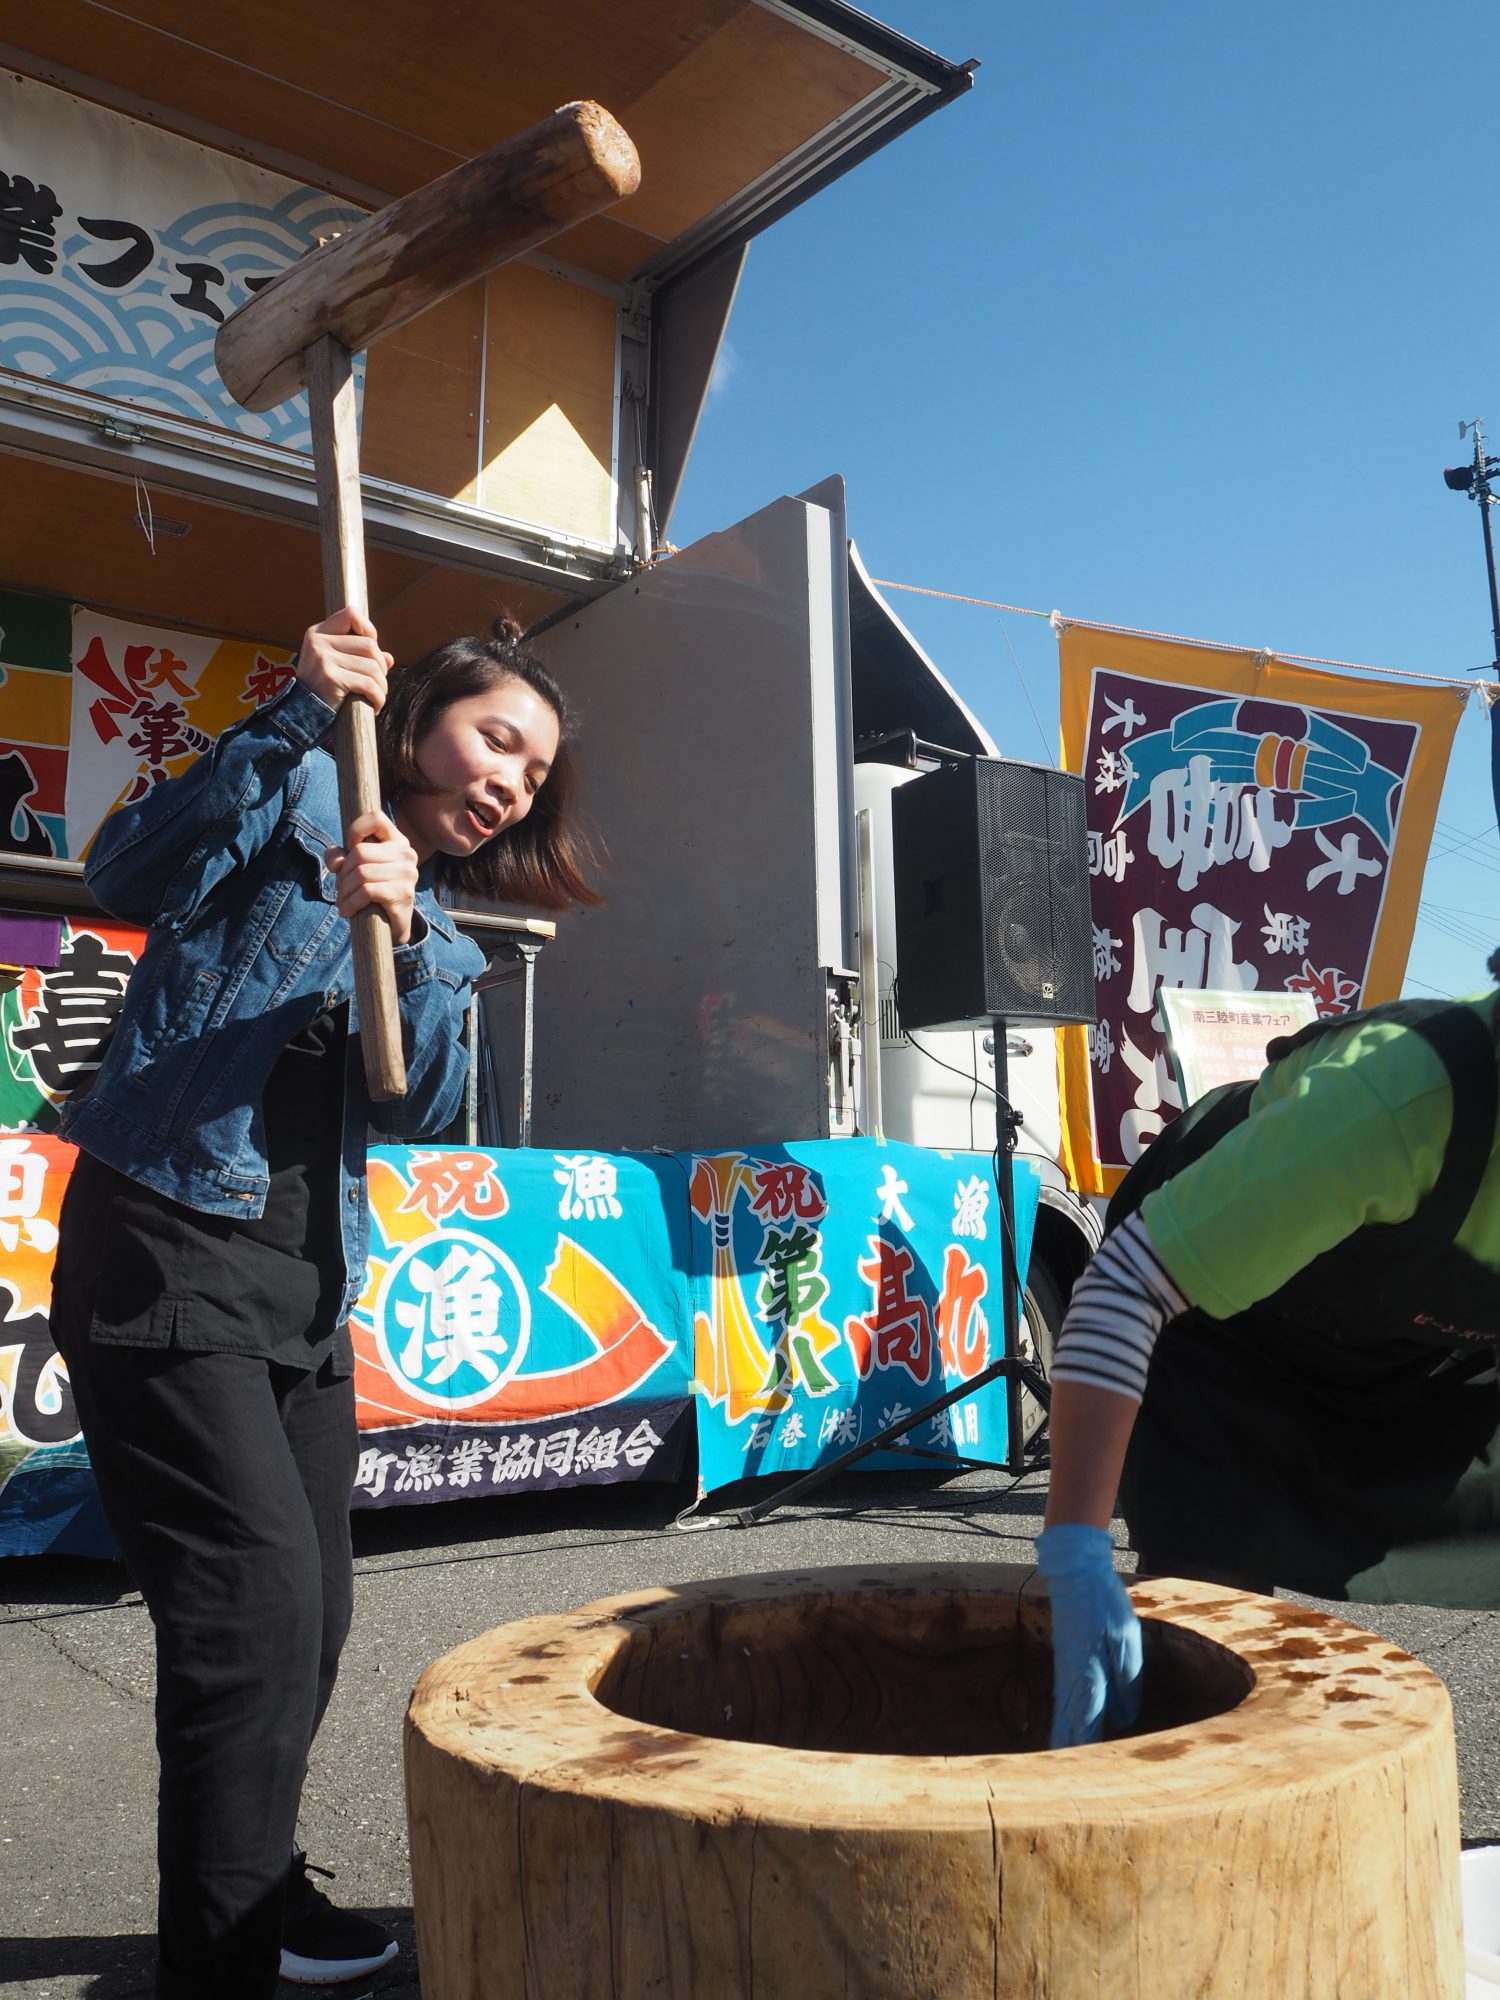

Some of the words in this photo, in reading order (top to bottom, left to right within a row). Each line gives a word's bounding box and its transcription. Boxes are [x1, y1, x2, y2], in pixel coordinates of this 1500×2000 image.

[0, 169, 276, 323] 業フェ
[1192, 1010, 1290, 1026] 南三陸町産業フェア
[396, 1150, 510, 1221] 祝
[553, 1154, 623, 1221] 漁
[749, 1157, 829, 1223] 祝
[353, 1418, 663, 1498] 町漁業協同組合
